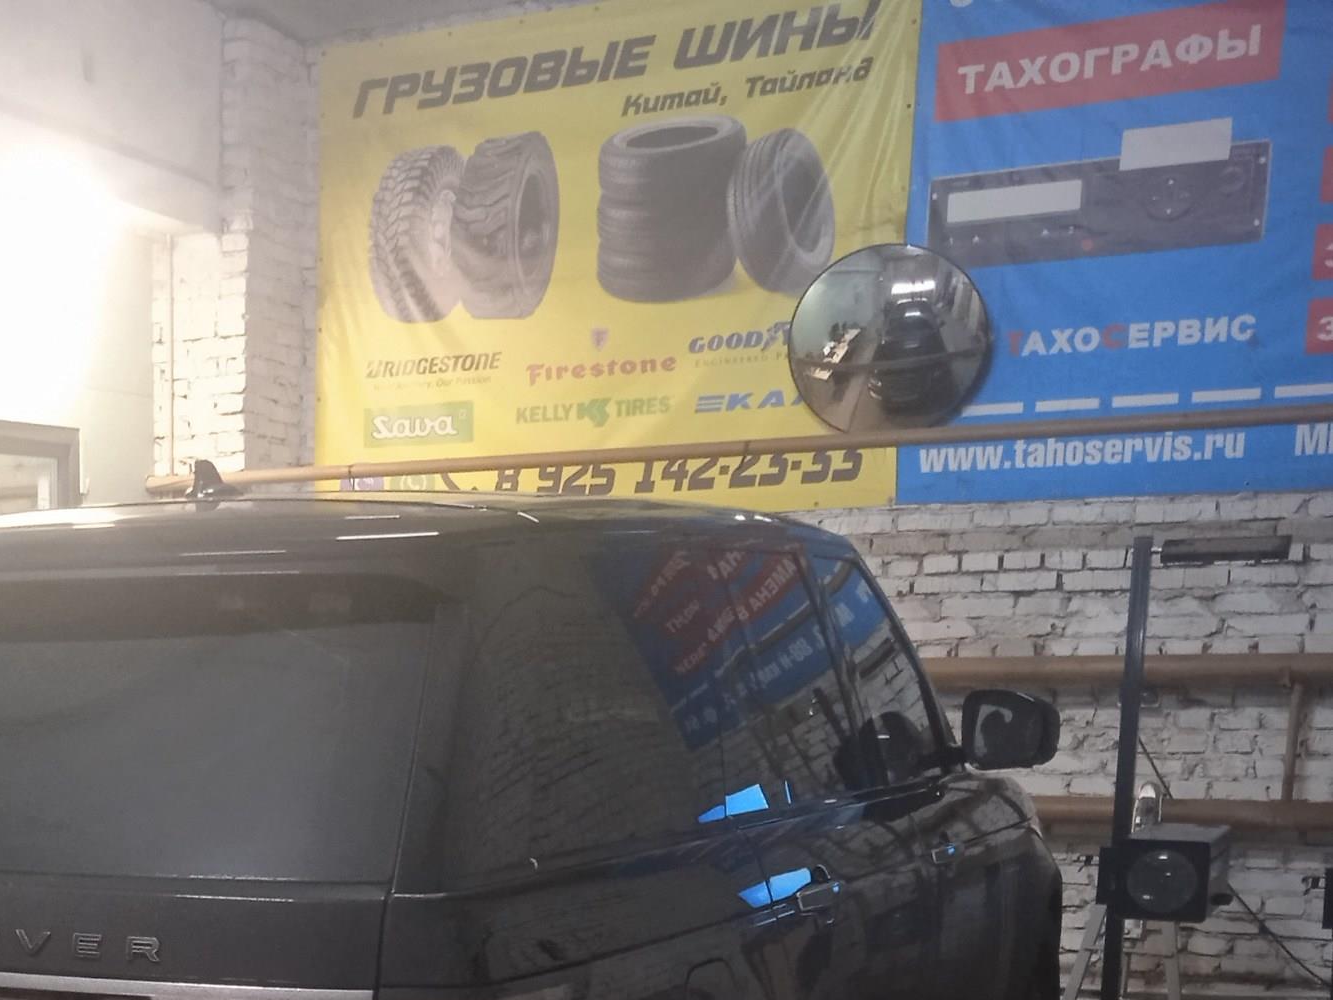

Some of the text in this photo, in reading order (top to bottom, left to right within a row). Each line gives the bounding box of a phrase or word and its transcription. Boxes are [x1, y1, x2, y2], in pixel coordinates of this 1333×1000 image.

[352, 0, 881, 119] ГРУЗОВЫЕ ШИНЫ
[957, 24, 1262, 94] ТАХОГРАФЫ
[621, 81, 728, 117] Китай,
[1008, 315, 1257, 357] ТАХОСЕРВИС
[366, 351, 502, 378] BRIDGESTONE
[526, 356, 677, 386] Firestone
[516, 396, 673, 424] KELLY TIRES
[919, 430, 1246, 474] www.tahoservis.ru
